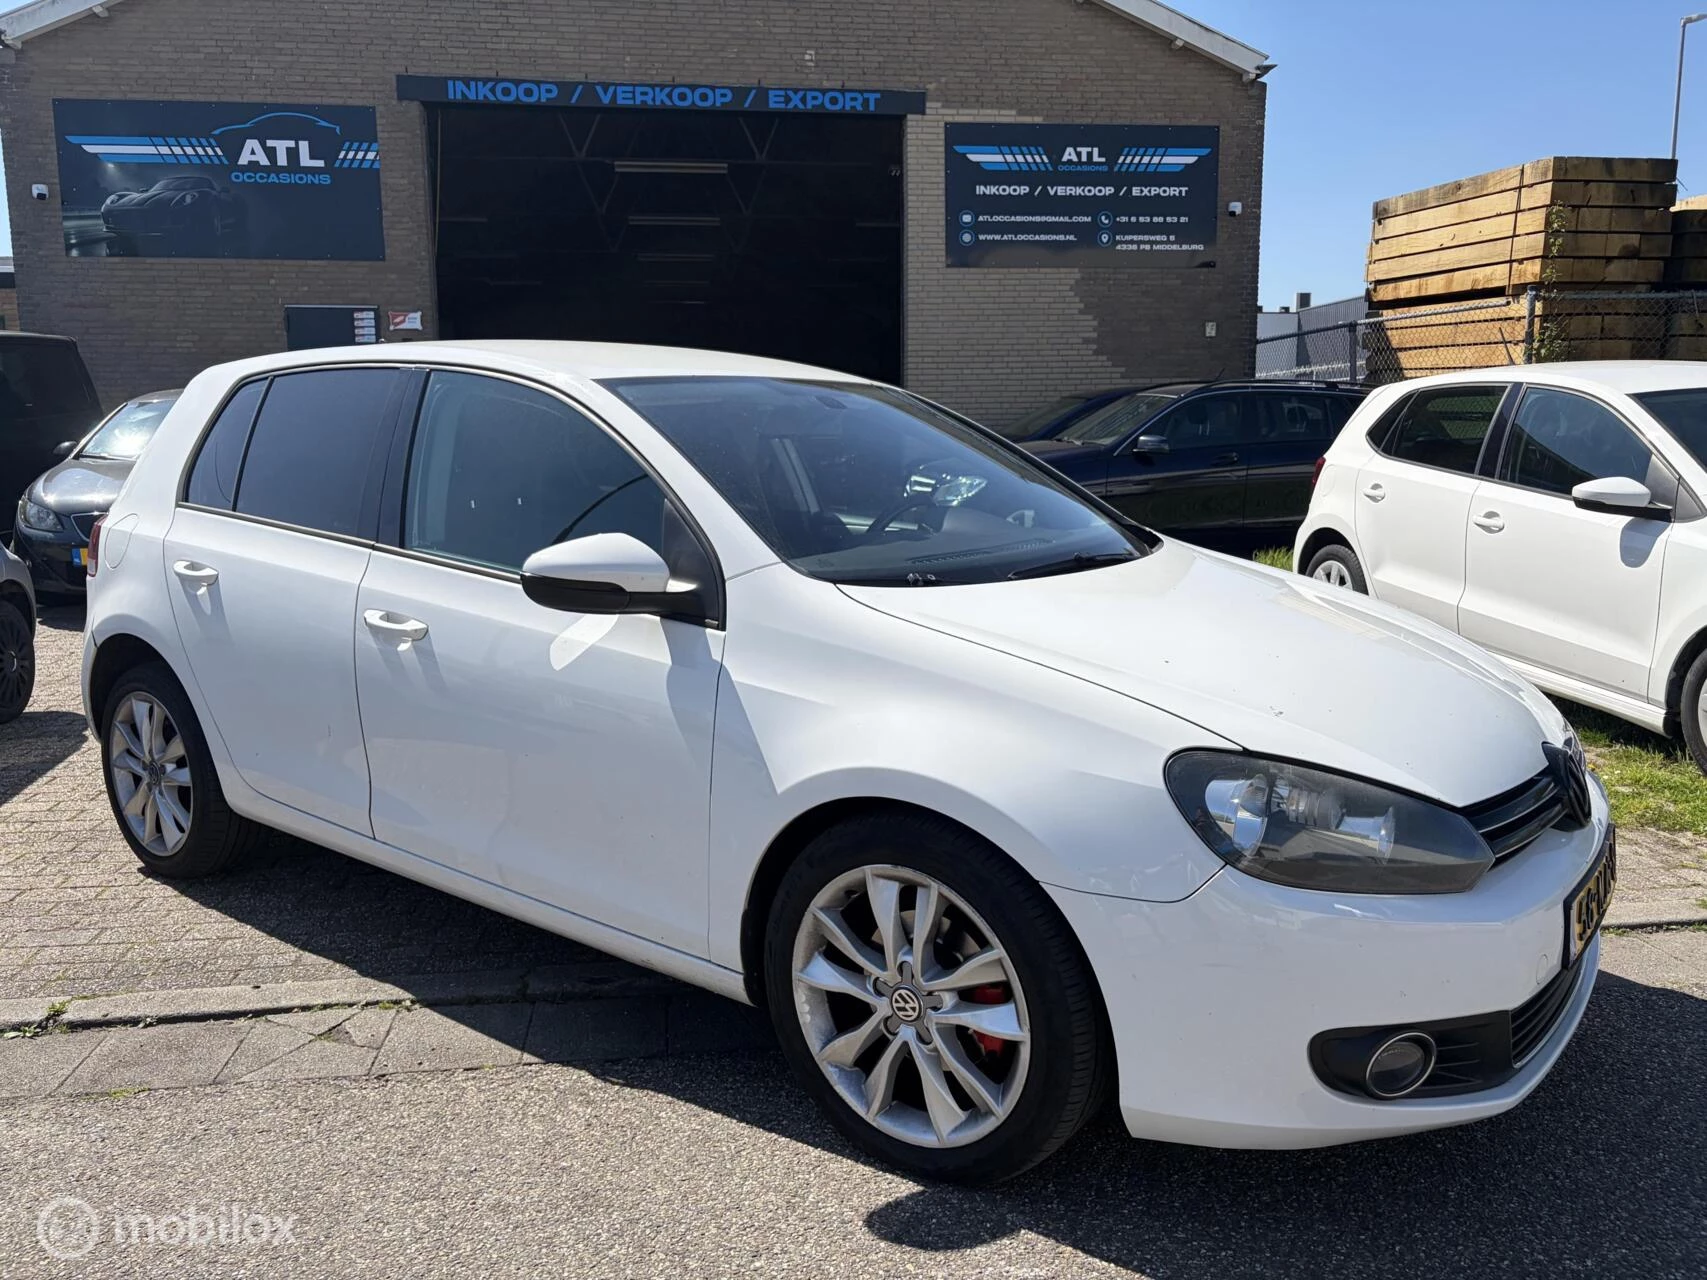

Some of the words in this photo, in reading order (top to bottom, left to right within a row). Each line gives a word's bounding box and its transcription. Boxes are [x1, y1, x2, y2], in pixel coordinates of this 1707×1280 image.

[447, 79, 558, 103] INKOOP
[571, 84, 584, 104] /
[595, 86, 733, 107] VERKOOP
[743, 89, 757, 108] /
[768, 90, 881, 112] EXPORT
[237, 138, 325, 168] ATL
[1061, 147, 1106, 163] ATL
[230, 171, 332, 185] OCCASIONS
[976, 185, 1030, 196] INKOOP
[1034, 186, 1042, 197] /
[1047, 186, 1115, 196] VERKOOP
[1119, 186, 1127, 197] /
[1132, 186, 1188, 197] EXPORT
